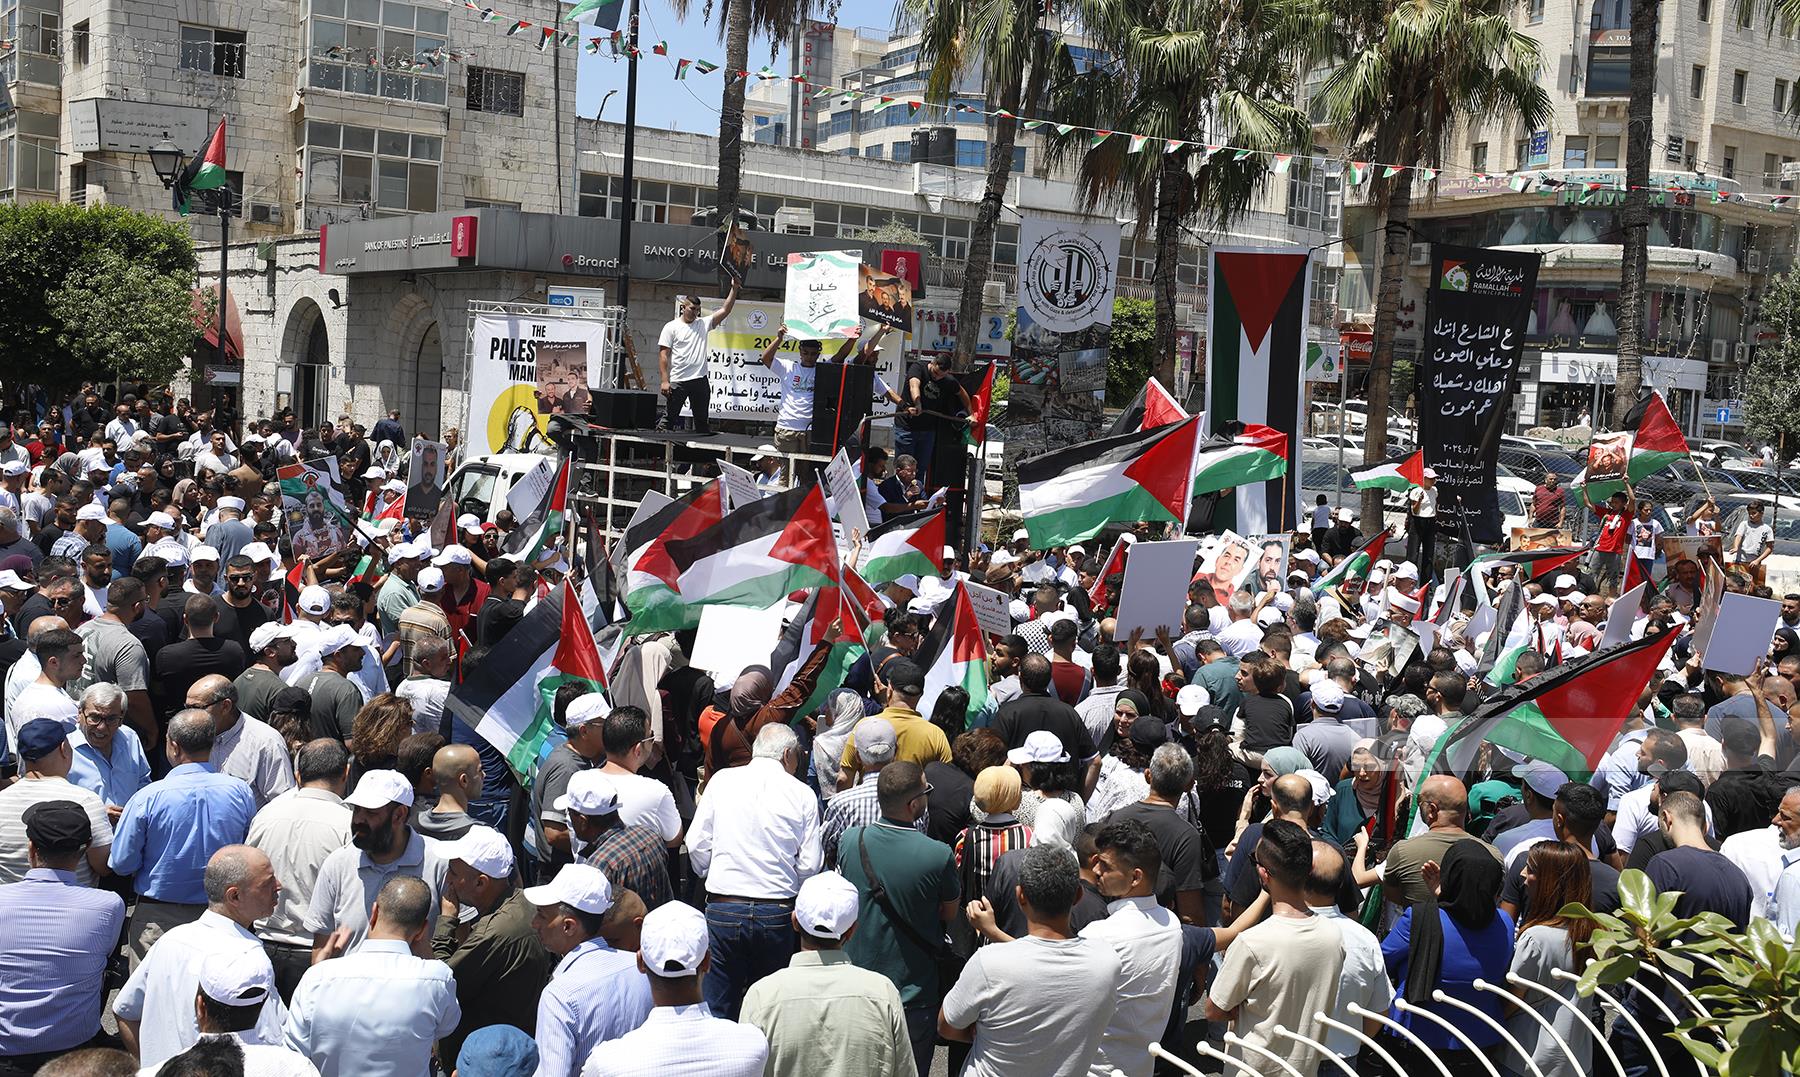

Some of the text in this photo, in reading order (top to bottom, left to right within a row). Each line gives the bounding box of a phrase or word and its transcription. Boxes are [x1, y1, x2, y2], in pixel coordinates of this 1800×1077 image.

[803, 42, 812, 120] BRIDAL
[643, 245, 675, 257] BANK
[677, 248, 694, 258] OF
[1472, 282, 1510, 292] RAMALLAH
[532, 325, 546, 338] THE
[989, 316, 1003, 340] 2
[1433, 318, 1456, 340] إنزل
[1458, 324, 1500, 346] الشارع
[1500, 327, 1514, 350] ع
[1433, 347, 1474, 363] الصوت
[714, 371, 734, 383] Day
[736, 373, 748, 382] of
[749, 374, 780, 386] Suppo
[1433, 372, 1508, 395] أهلك وشعبك
[724, 401, 770, 413] Genocide
[772, 404, 780, 414] &
[1440, 400, 1476, 417] بموت
